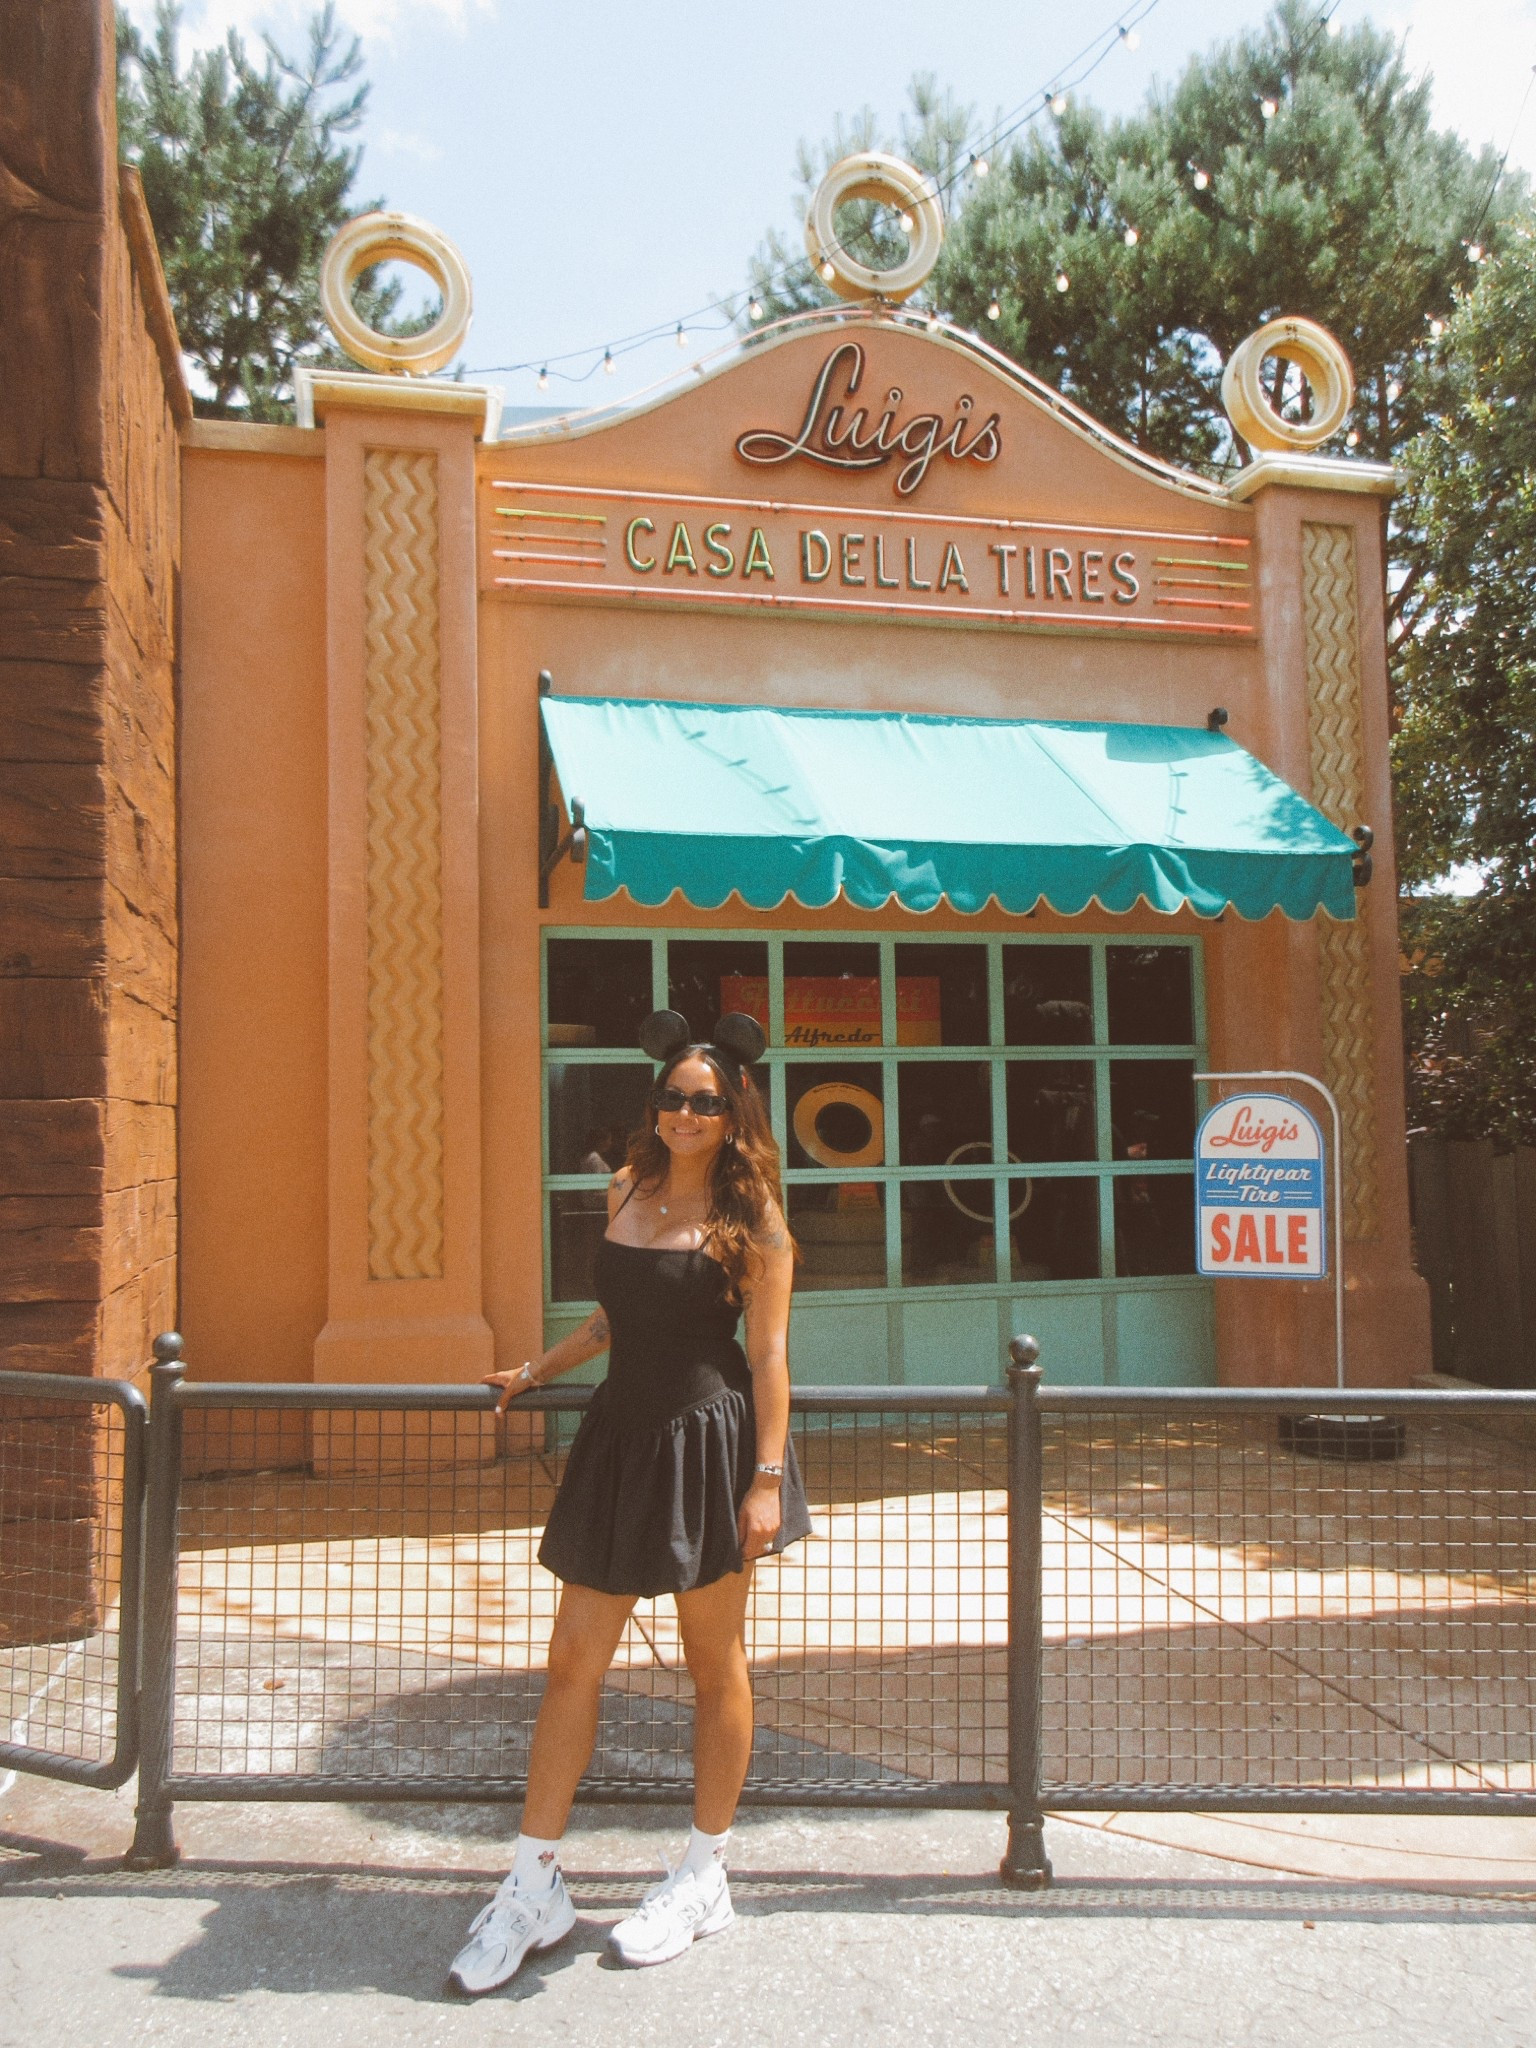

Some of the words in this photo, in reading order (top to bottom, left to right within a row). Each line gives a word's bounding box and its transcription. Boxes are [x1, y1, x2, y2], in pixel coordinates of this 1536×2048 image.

[736, 342, 1001, 496] Luigis
[625, 517, 776, 579] CASA
[802, 530, 969, 593] DELLA
[990, 544, 1140, 603] TIRES
[784, 1026, 880, 1047] Alfredo
[1209, 1106, 1299, 1153] Luigis
[1206, 1163, 1312, 1185] Lightyear
[1239, 1185, 1282, 1202] Tire
[1211, 1213, 1308, 1264] SALE
